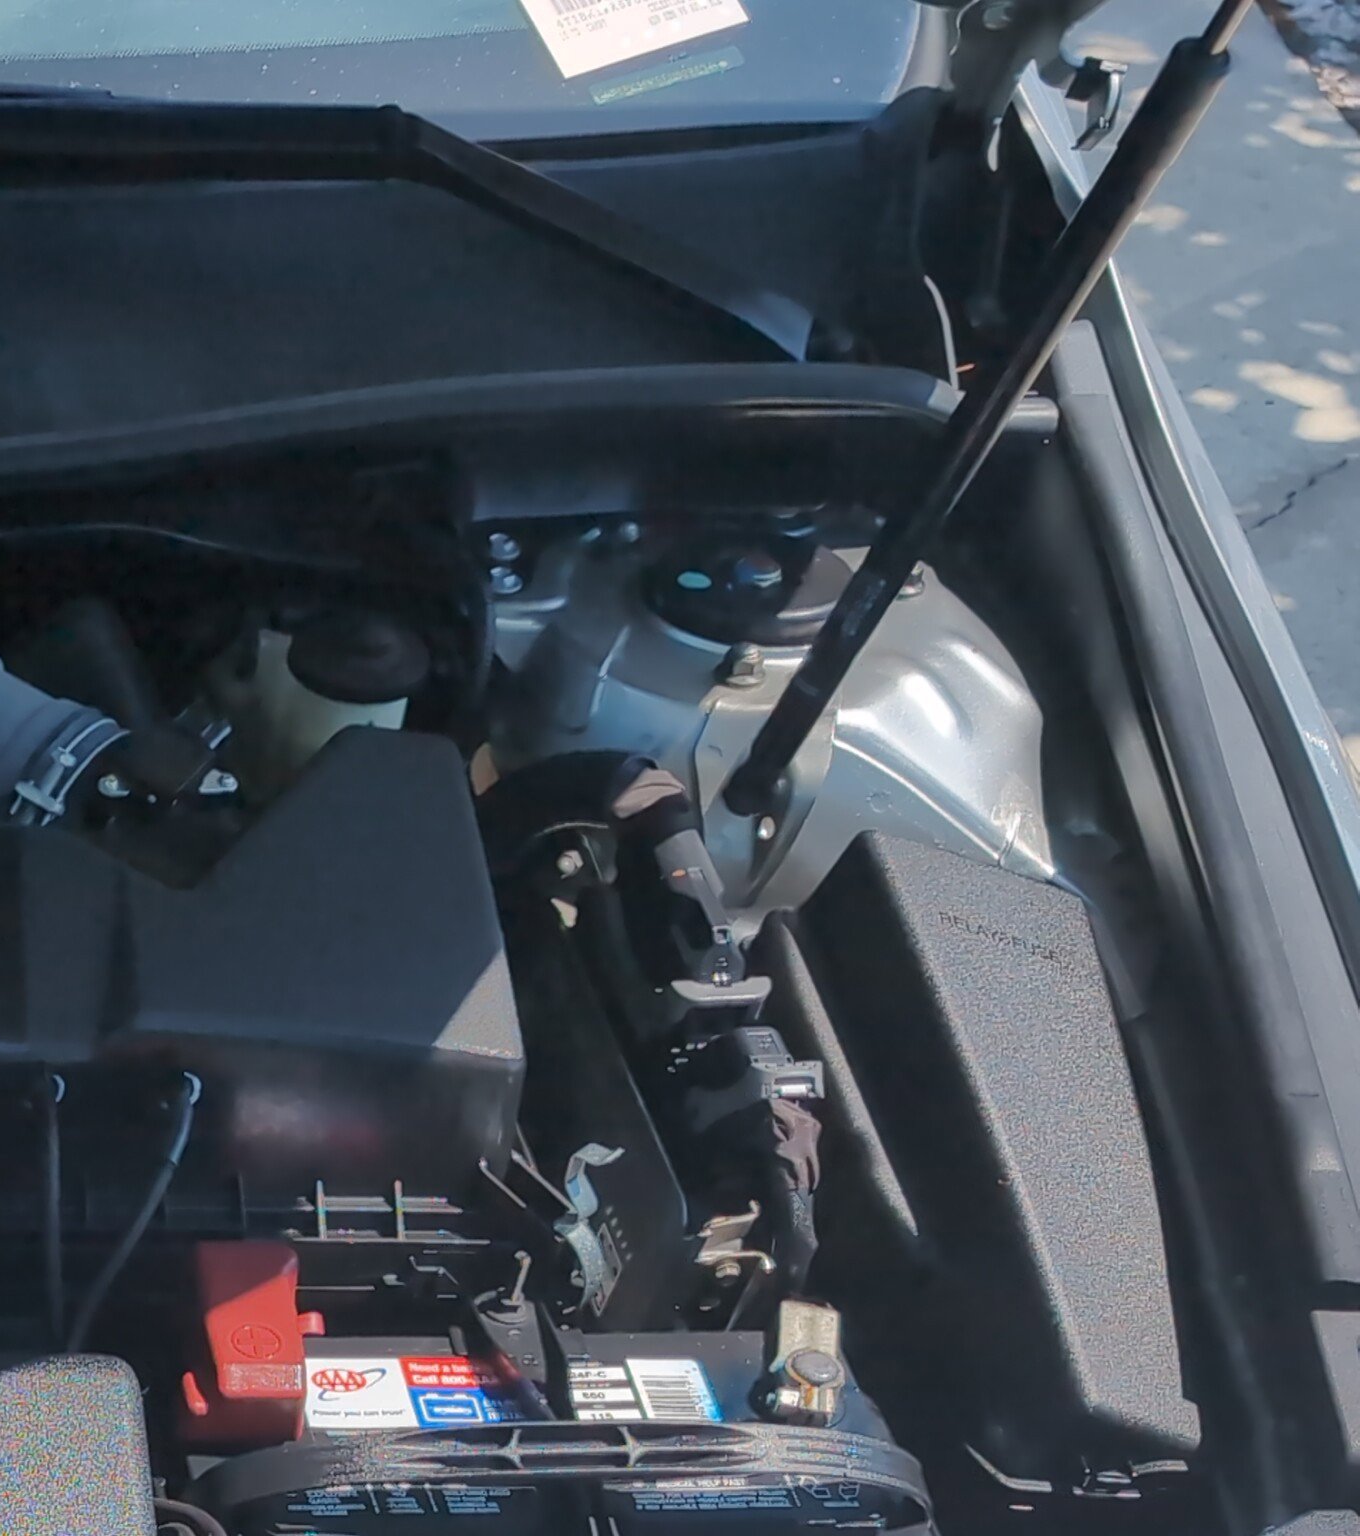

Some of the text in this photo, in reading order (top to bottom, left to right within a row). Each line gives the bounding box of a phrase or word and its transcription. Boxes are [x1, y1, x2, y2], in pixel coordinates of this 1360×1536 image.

[312, 1369, 366, 1392] AAA
[412, 1374, 439, 1385] Call
[343, 1409, 361, 1418] you
